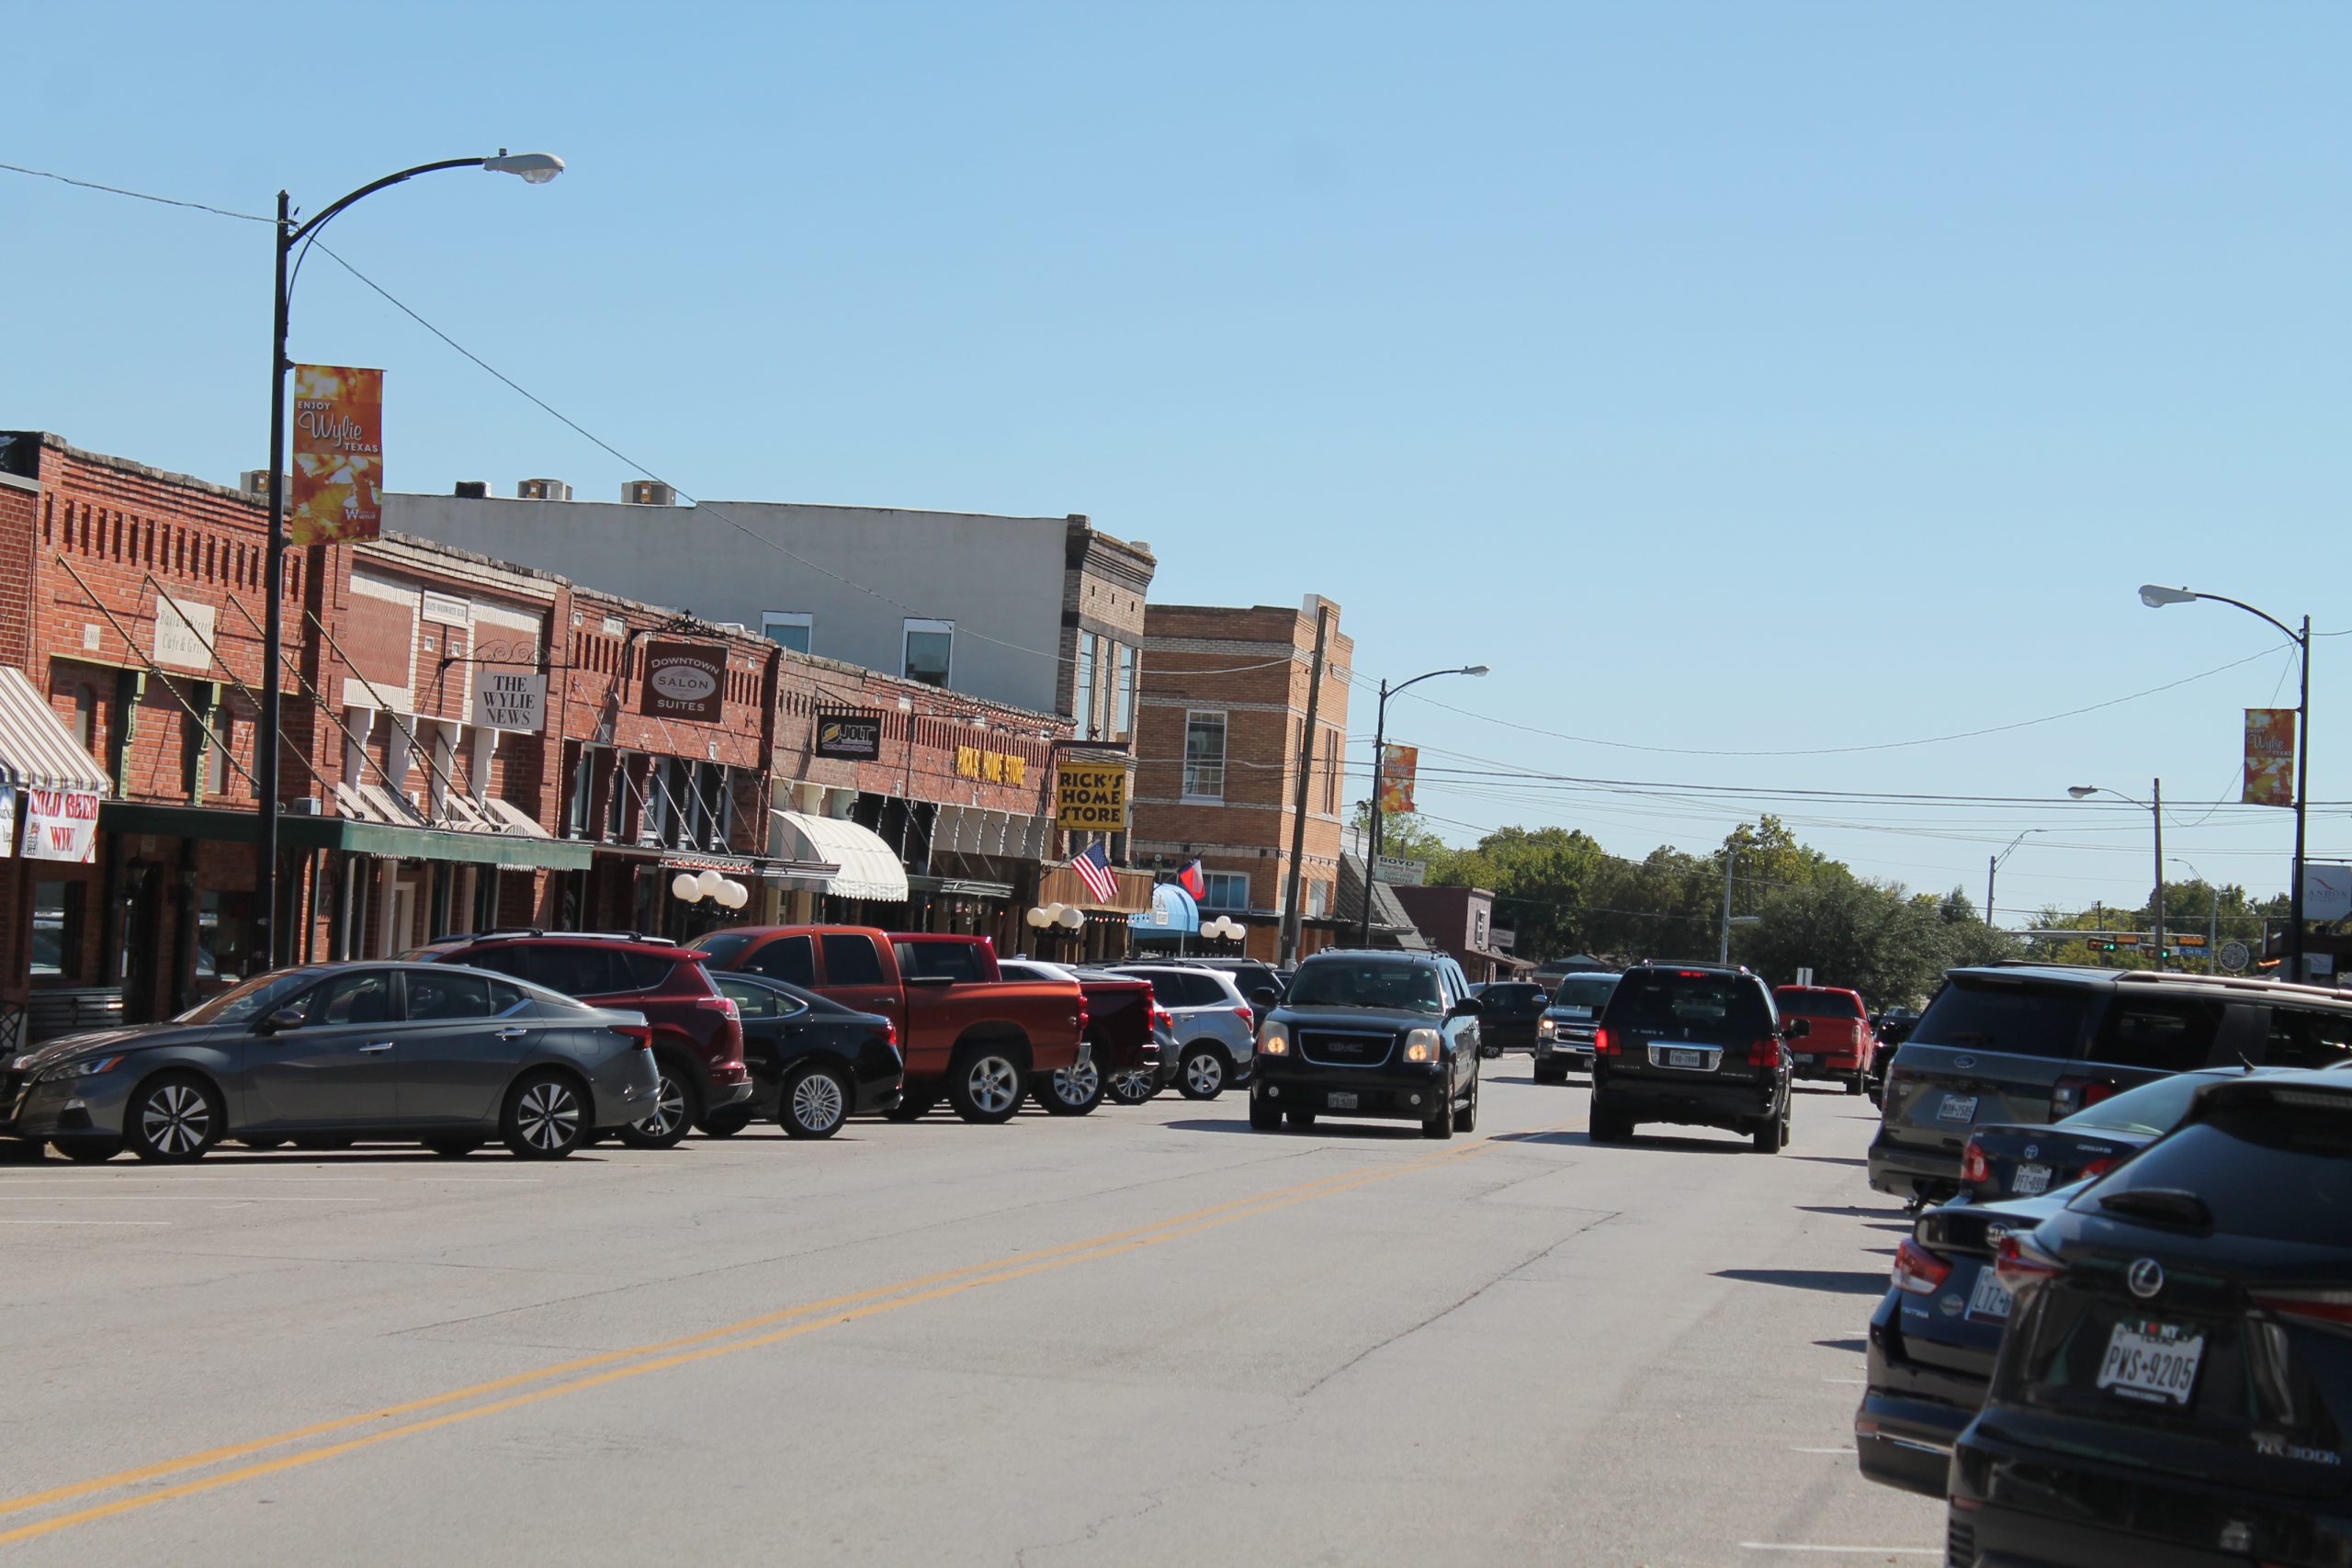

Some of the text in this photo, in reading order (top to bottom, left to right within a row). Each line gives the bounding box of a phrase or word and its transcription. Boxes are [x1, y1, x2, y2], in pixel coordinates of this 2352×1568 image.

[298, 401, 331, 410] ENJOY
[299, 411, 363, 447] Wylie
[345, 442, 379, 453] TEXAS
[190, 615, 211, 633] Street
[163, 634, 180, 652] Cafe
[187, 641, 206, 655] Grill
[493, 676, 526, 692] THE
[658, 676, 708, 690] SALON
[483, 692, 535, 709] WYLIE
[657, 699, 705, 712] SUITES
[485, 708, 530, 726] NEWS
[841, 725, 876, 740] JOLT
[984, 750, 1003, 782] HOME
[1005, 754, 1025, 784] STORE
[1058, 772, 1124, 788] RICK'S
[30, 789, 97, 820] COLD BEER
[1061, 789, 1121, 805] HOME
[1059, 807, 1120, 822] STORE
[1385, 875, 1413, 884] TRANSFER
